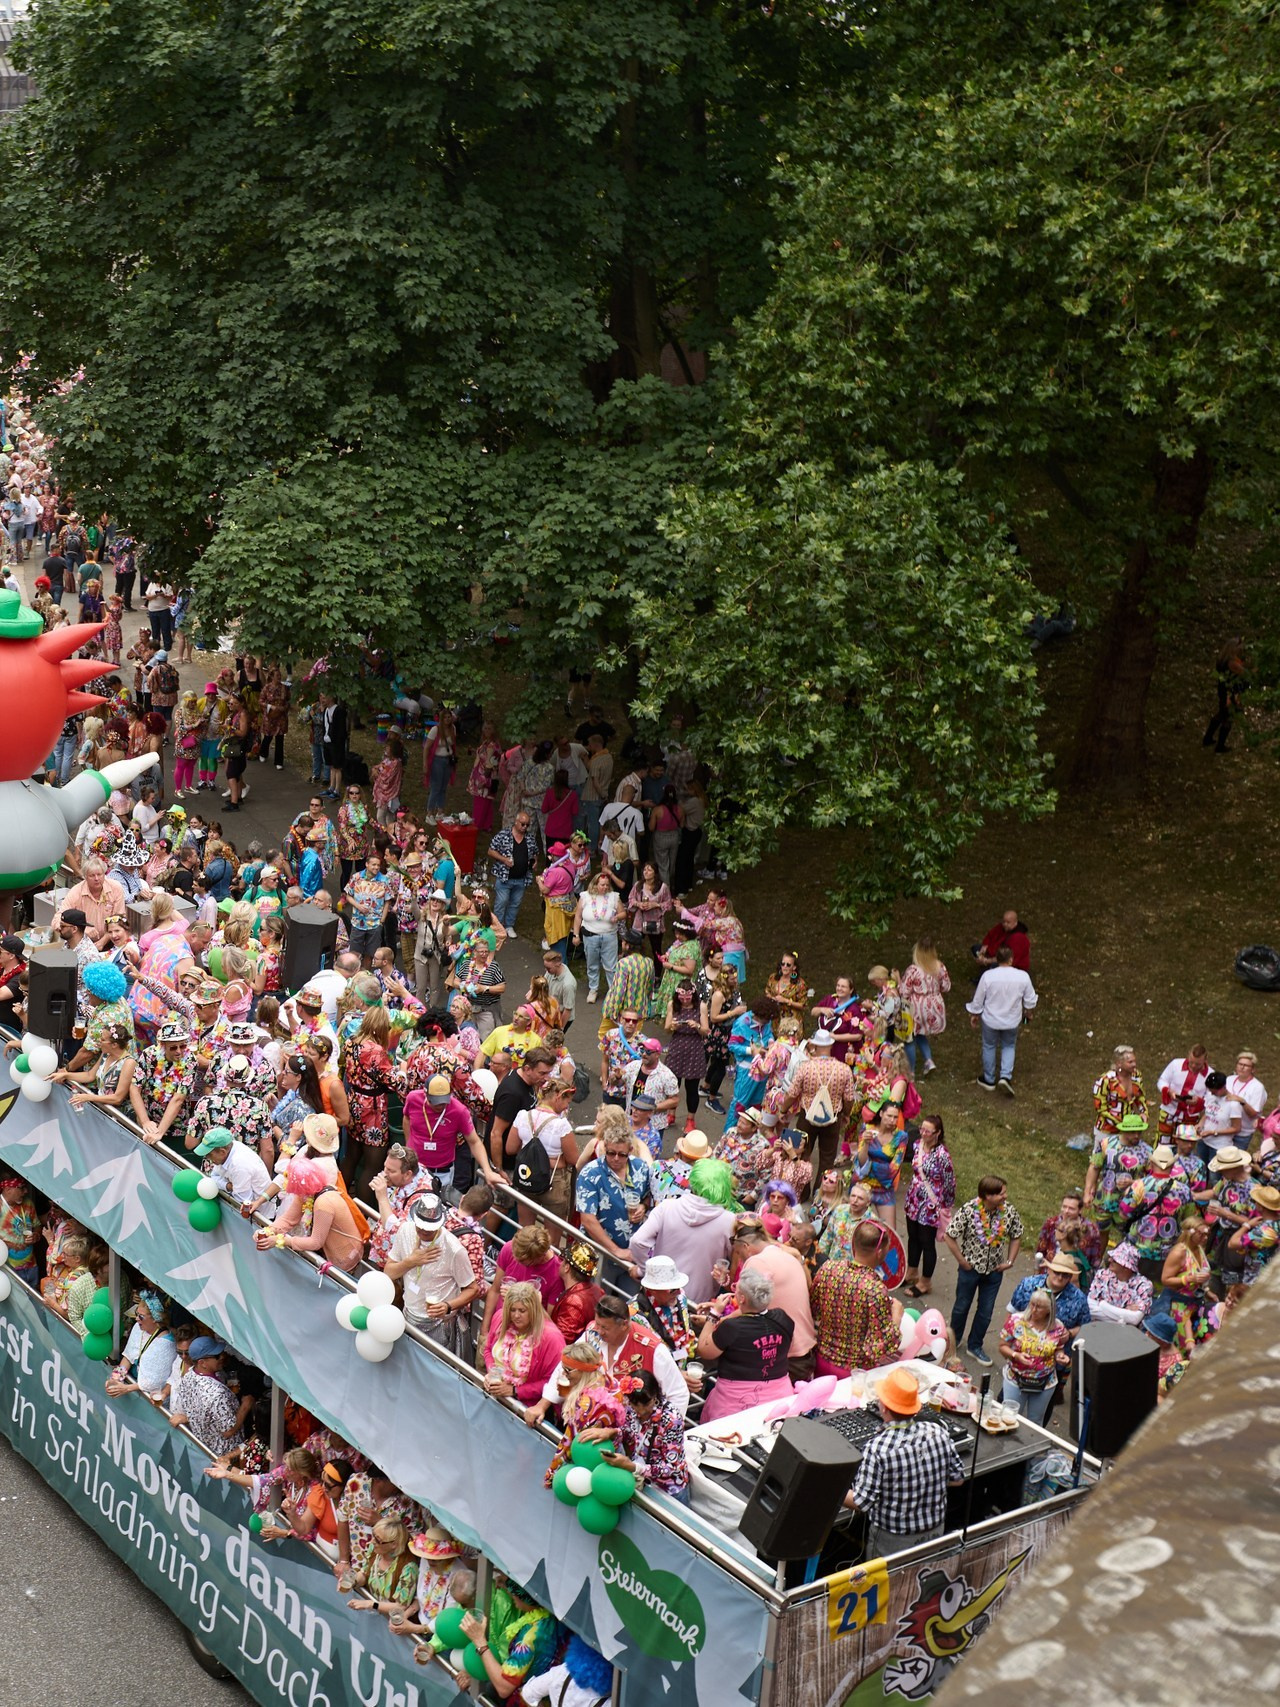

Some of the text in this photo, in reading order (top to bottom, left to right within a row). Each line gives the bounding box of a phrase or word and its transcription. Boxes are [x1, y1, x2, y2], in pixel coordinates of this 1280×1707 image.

[753, 1334, 783, 1349] TEAM
[11, 1377, 36, 1439] in
[41, 1349, 94, 1434] der
[101, 1404, 211, 1560] Move,
[225, 1523, 333, 1670] dann
[600, 1549, 700, 1658] Steiermark
[836, 1584, 879, 1635] 21
